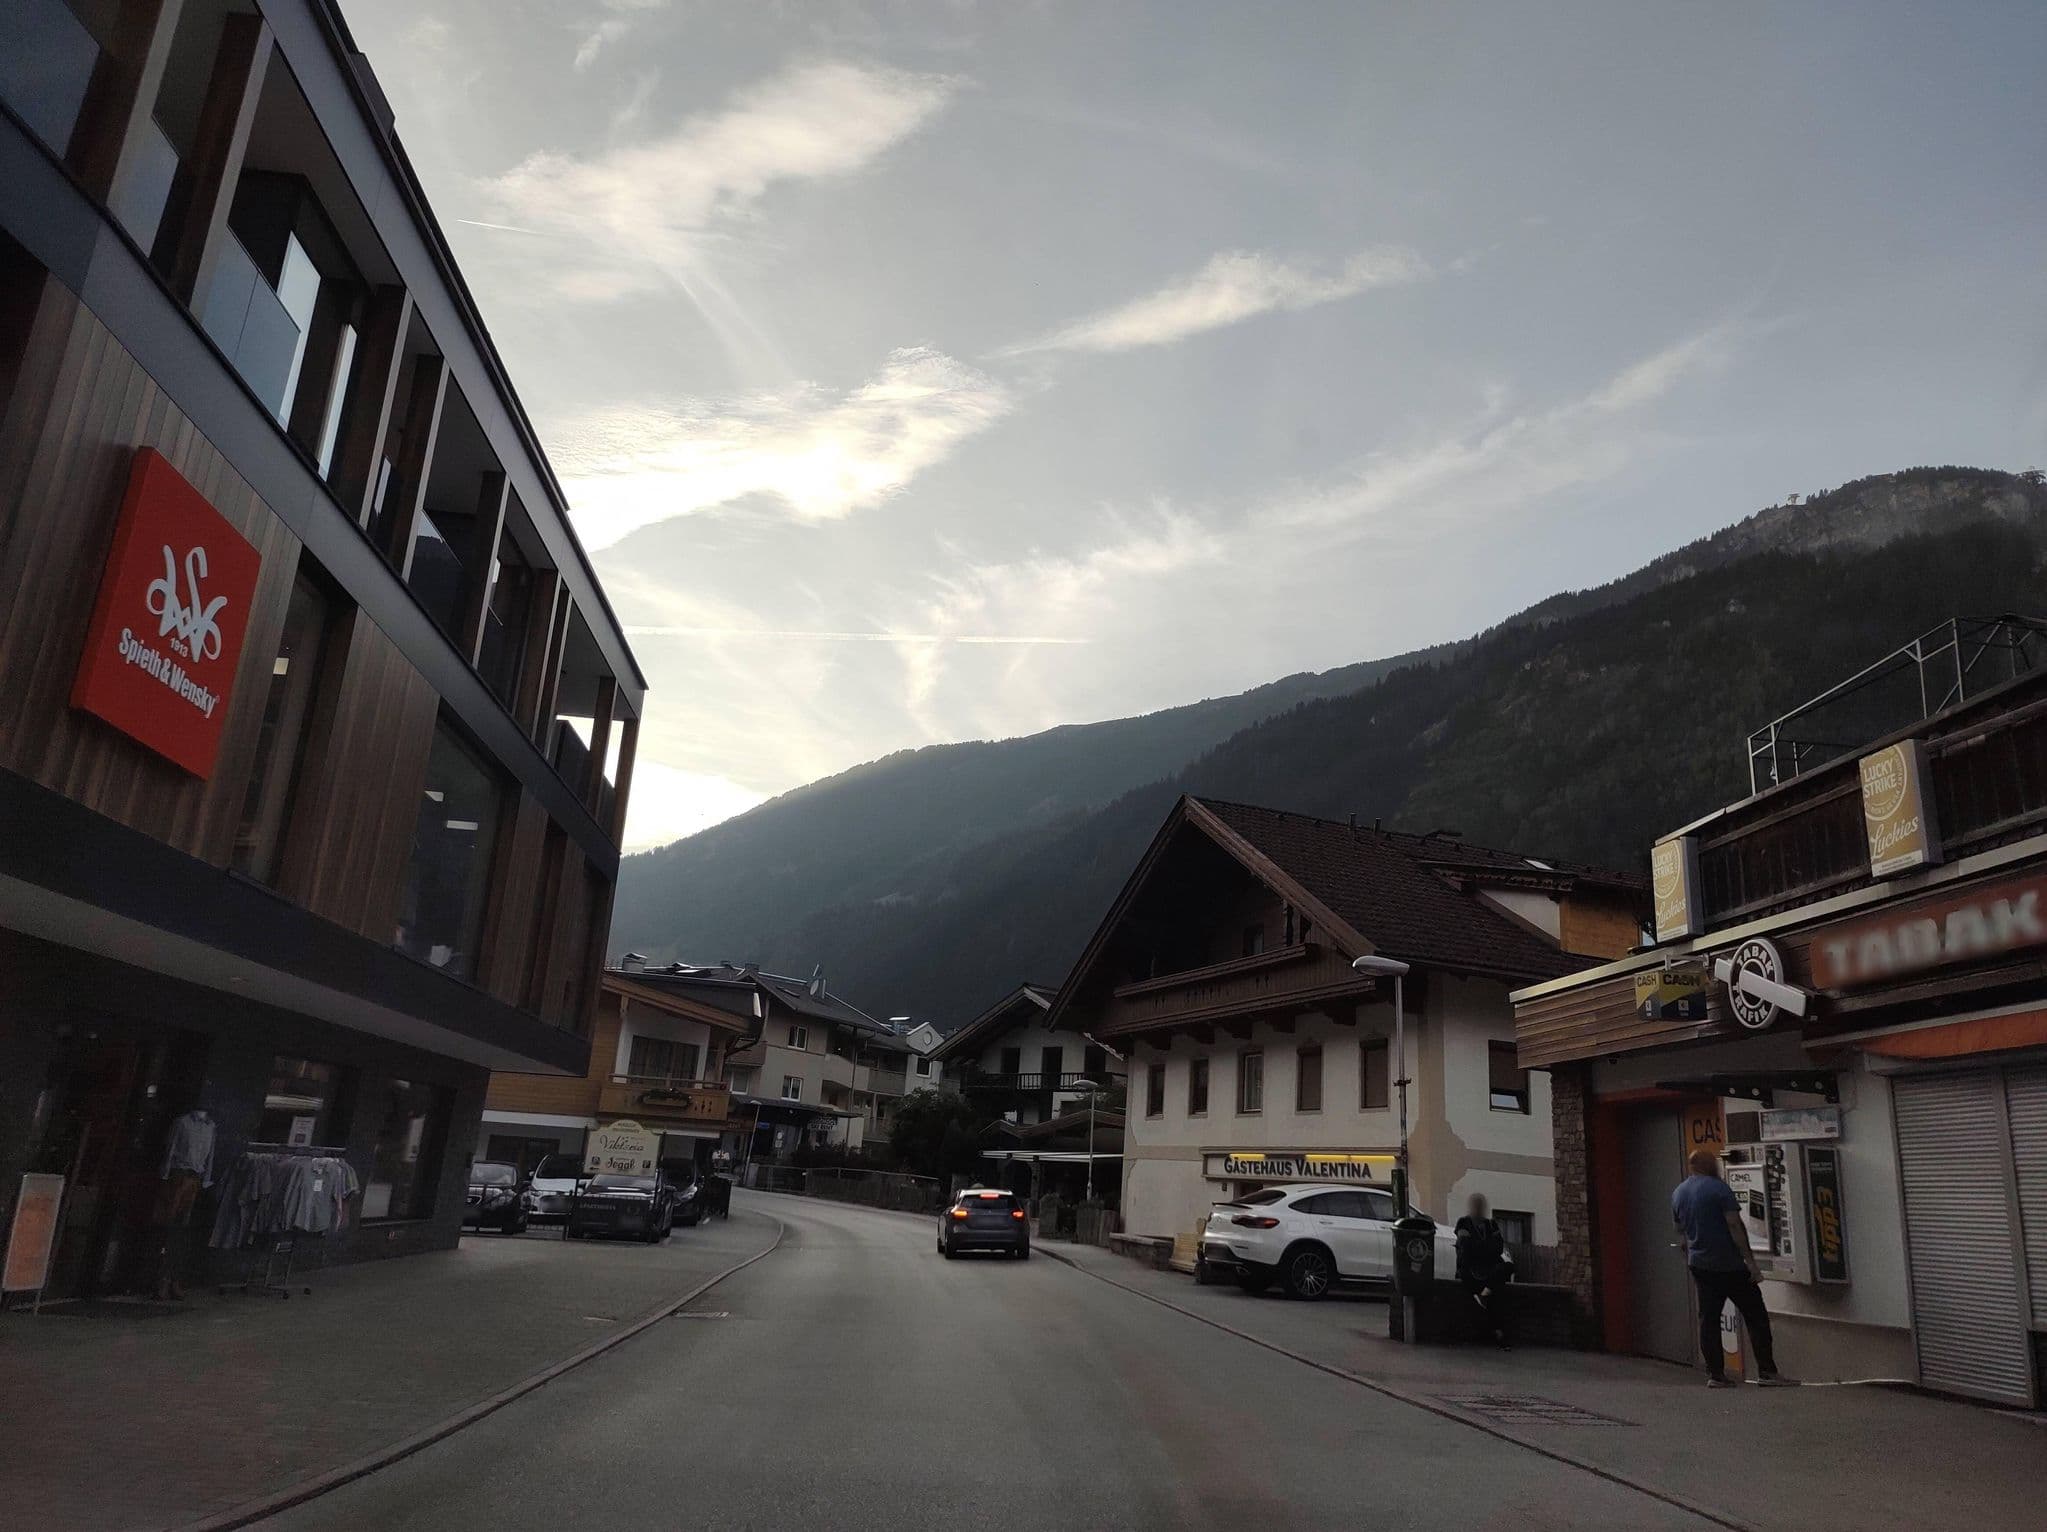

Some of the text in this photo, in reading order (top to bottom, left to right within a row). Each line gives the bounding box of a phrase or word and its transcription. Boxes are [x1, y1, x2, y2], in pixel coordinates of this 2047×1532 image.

[1863, 758, 1894, 782] LUCKY
[1863, 773, 1897, 798] STRIKE
[1871, 816, 1919, 859] Luckies
[1736, 945, 1774, 974] TABAK
[1637, 974, 1657, 988] CASH
[1663, 974, 1700, 986] CASH
[1731, 981, 1770, 1023] TRAFIK
[1224, 1156, 1373, 1179] GÄSTEHAUS VALENTINA
[1730, 1173, 1752, 1183] CAMEL
